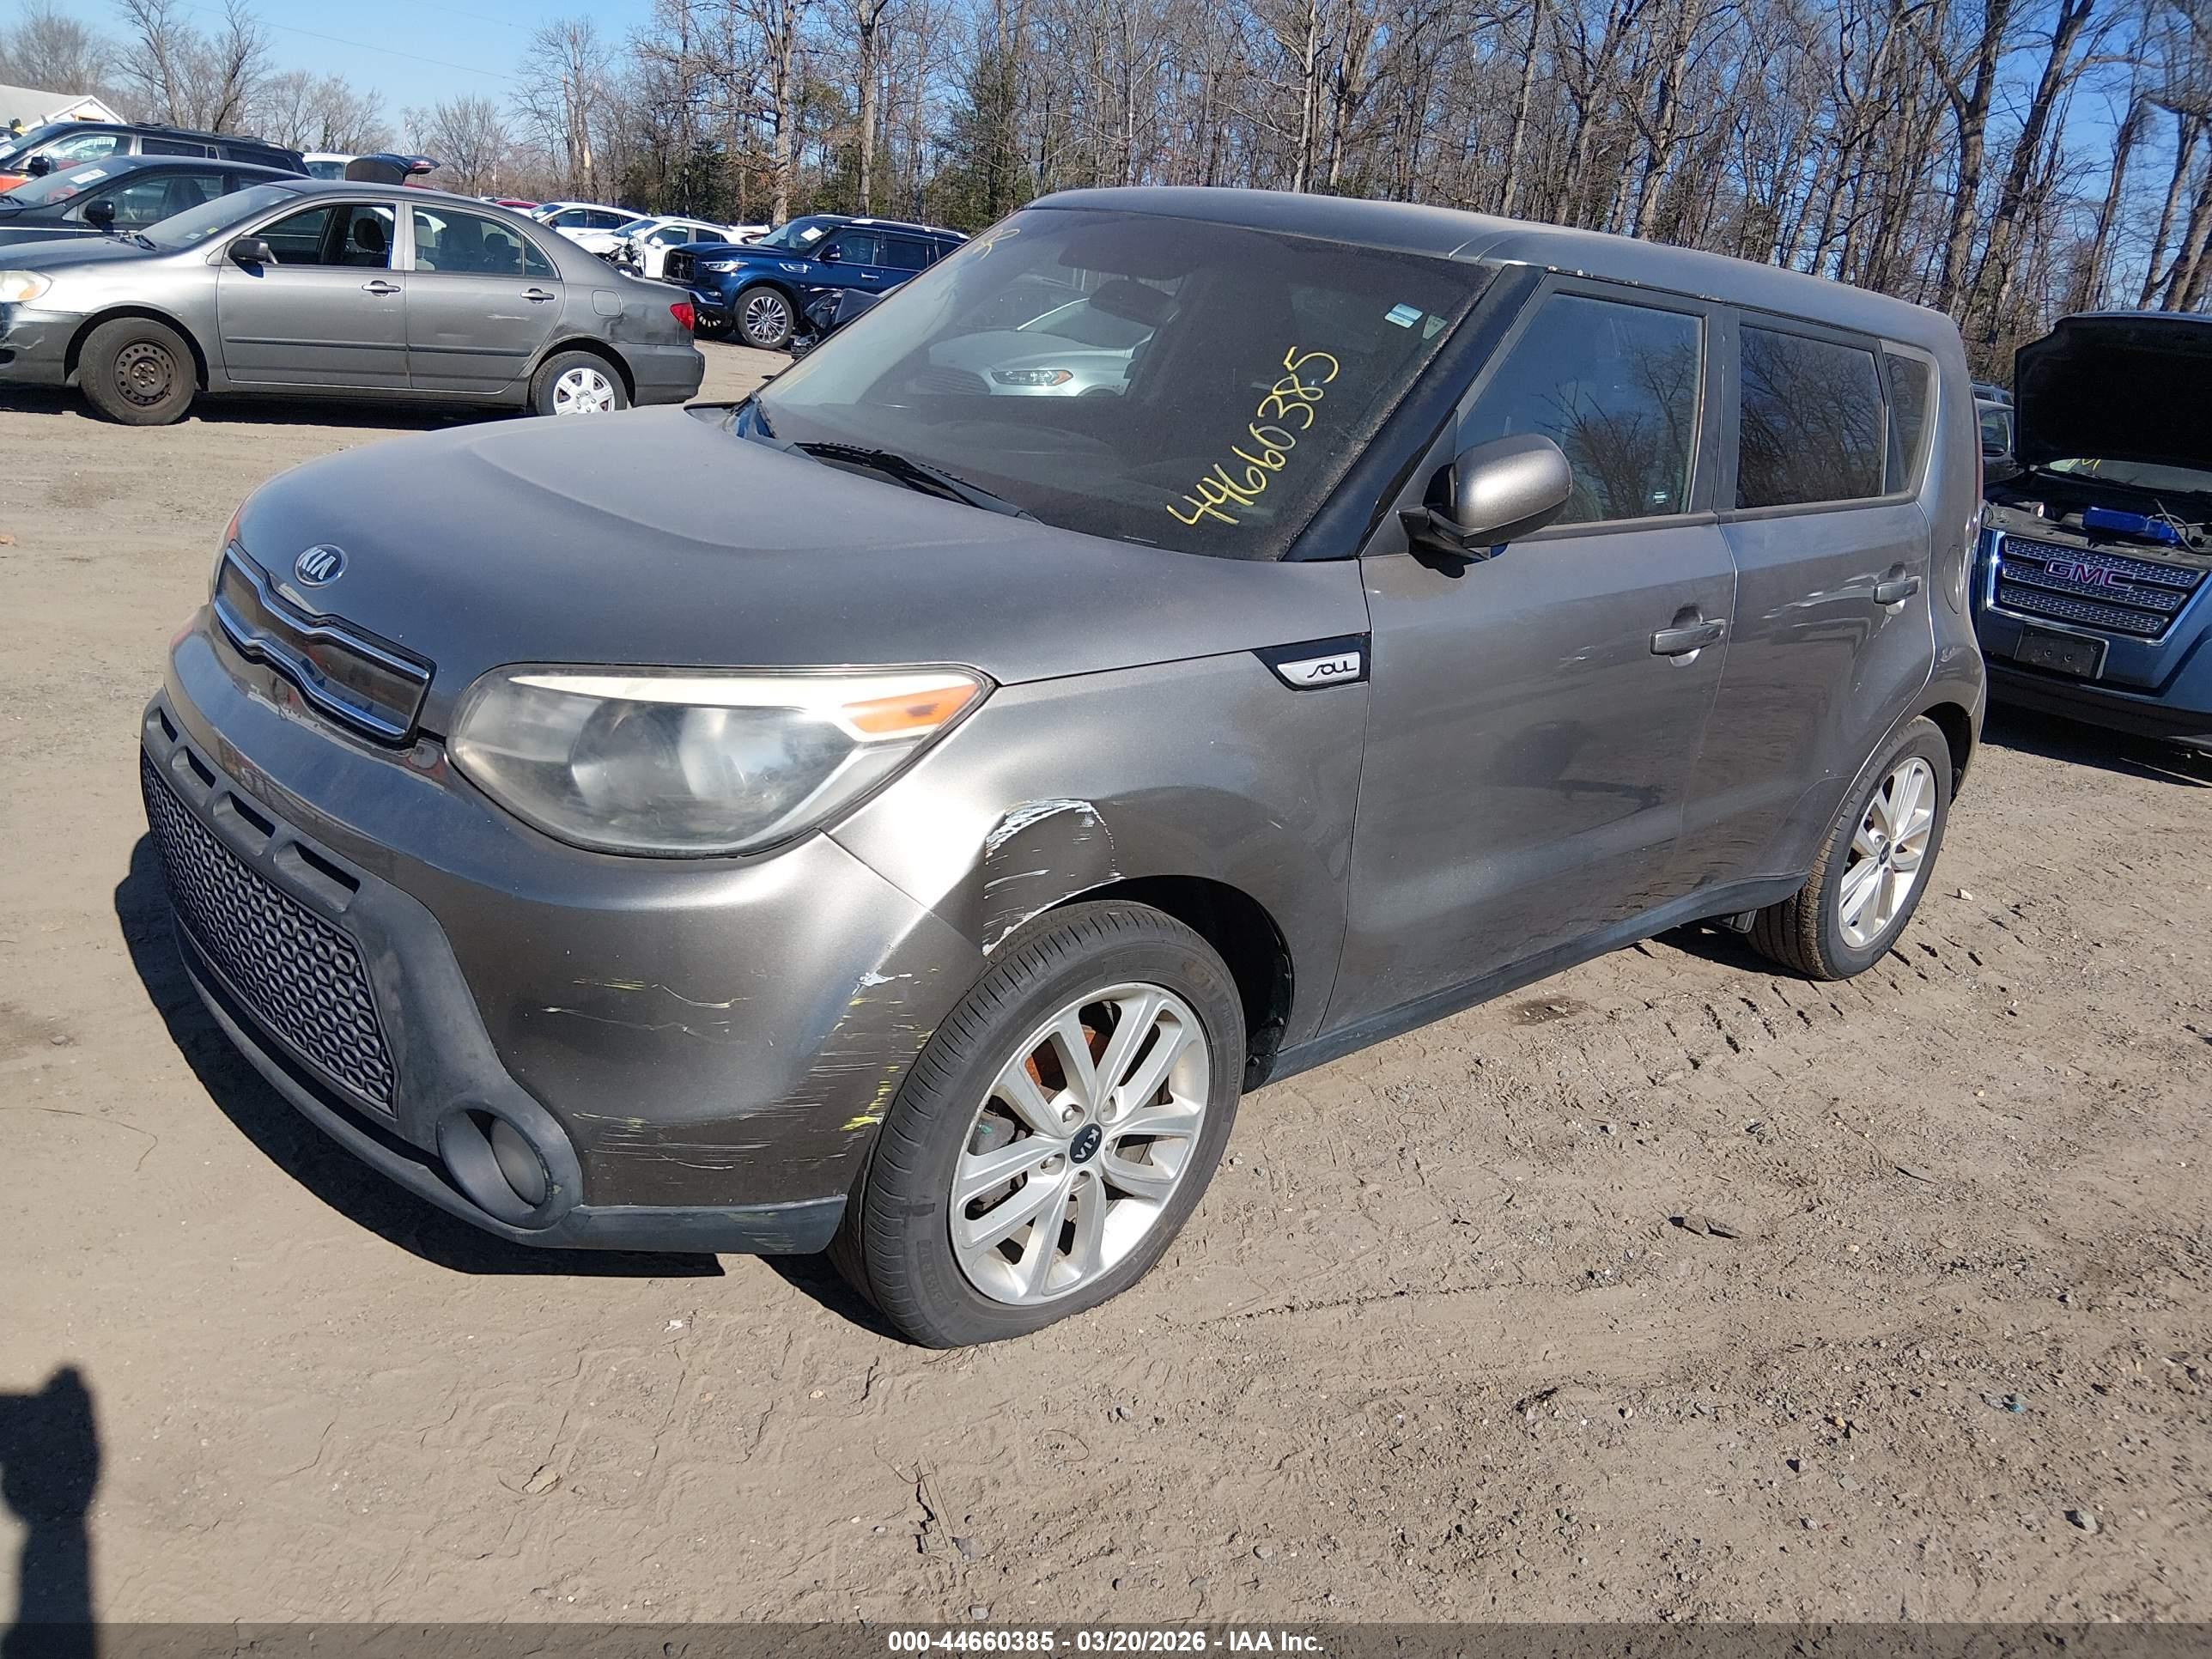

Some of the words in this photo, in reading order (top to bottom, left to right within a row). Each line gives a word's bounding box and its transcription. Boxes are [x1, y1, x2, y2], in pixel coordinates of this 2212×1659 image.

[1166, 345, 1340, 526] 44660385
[298, 546, 337, 580] KIA
[2044, 556, 2136, 592] GMC
[1074, 1128, 1100, 1159] KIA
